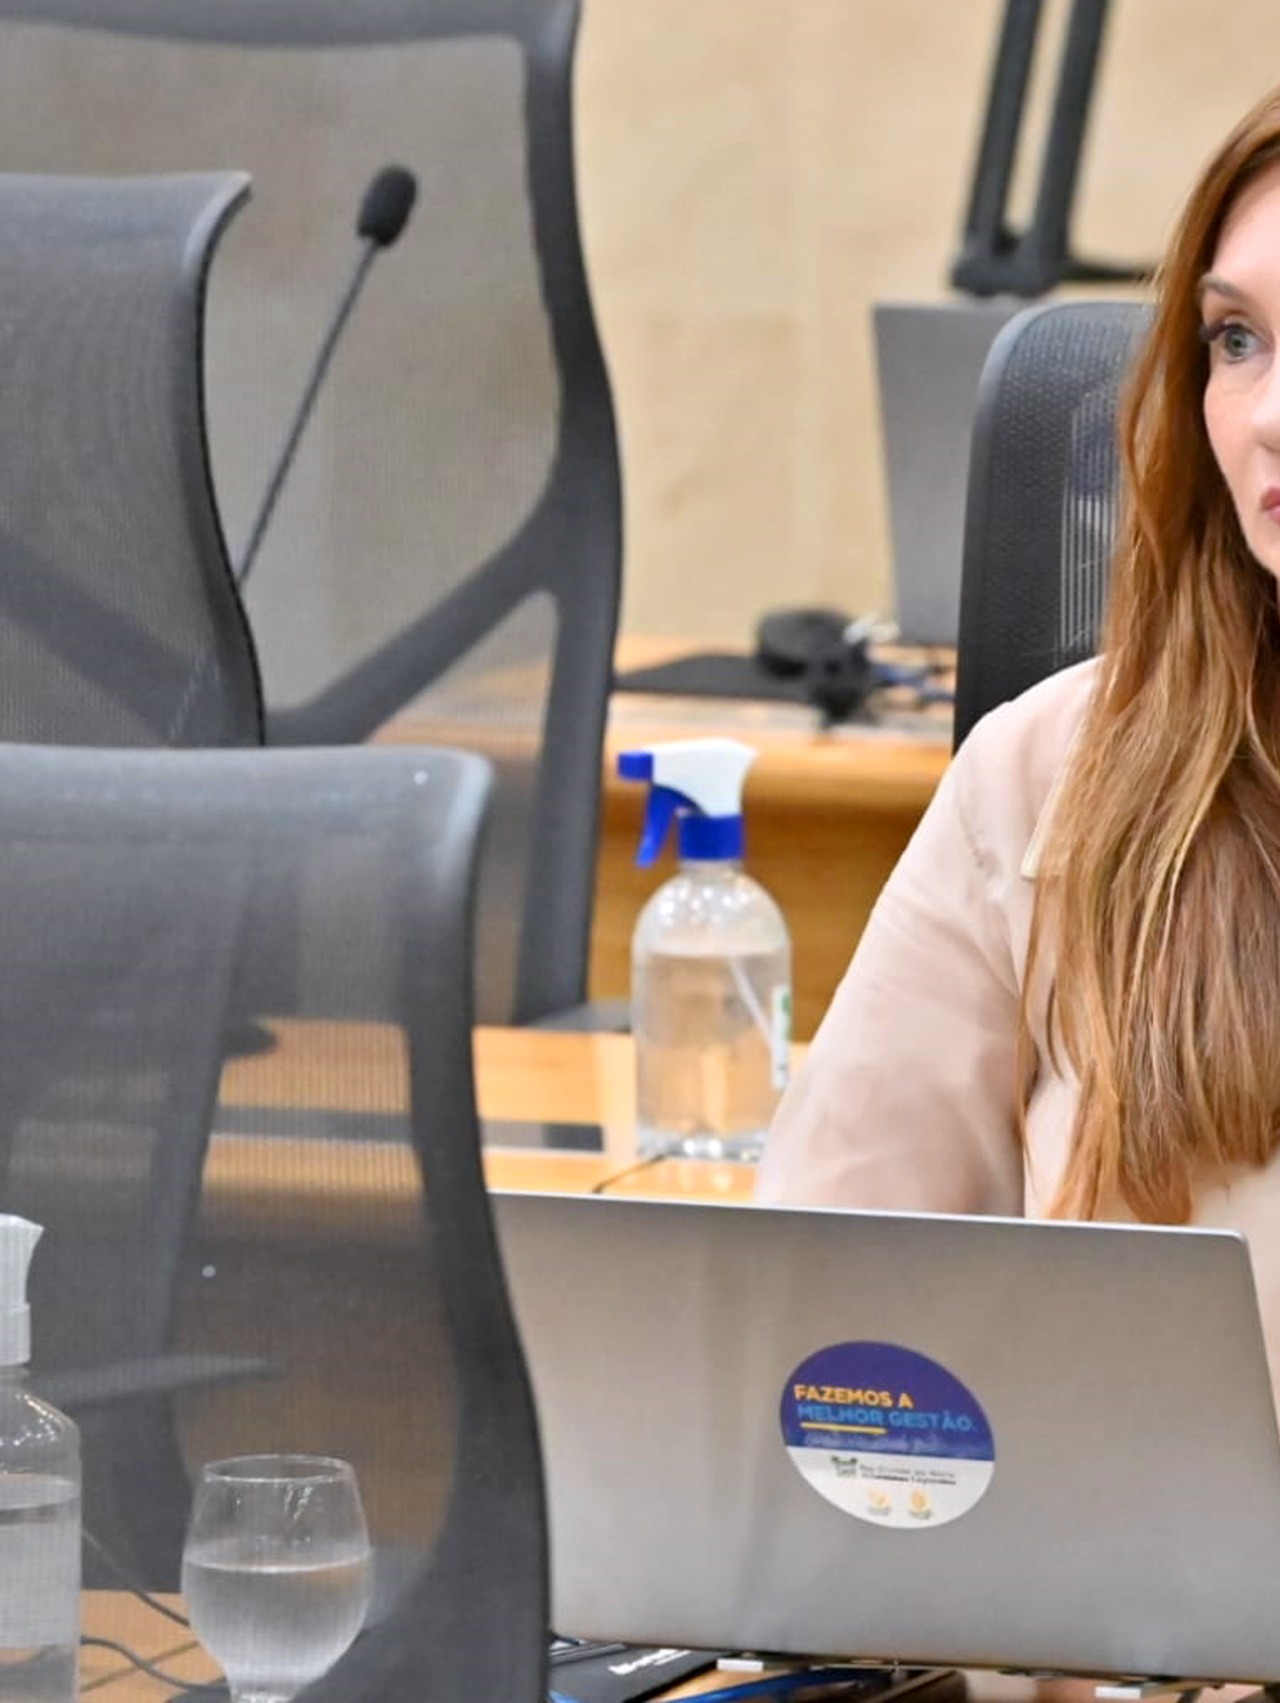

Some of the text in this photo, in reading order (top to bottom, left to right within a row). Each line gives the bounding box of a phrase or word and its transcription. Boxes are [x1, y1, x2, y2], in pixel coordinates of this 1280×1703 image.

[794, 1384, 914, 1409] FAZEMOS A
[797, 1403, 883, 1425] MELHOR
